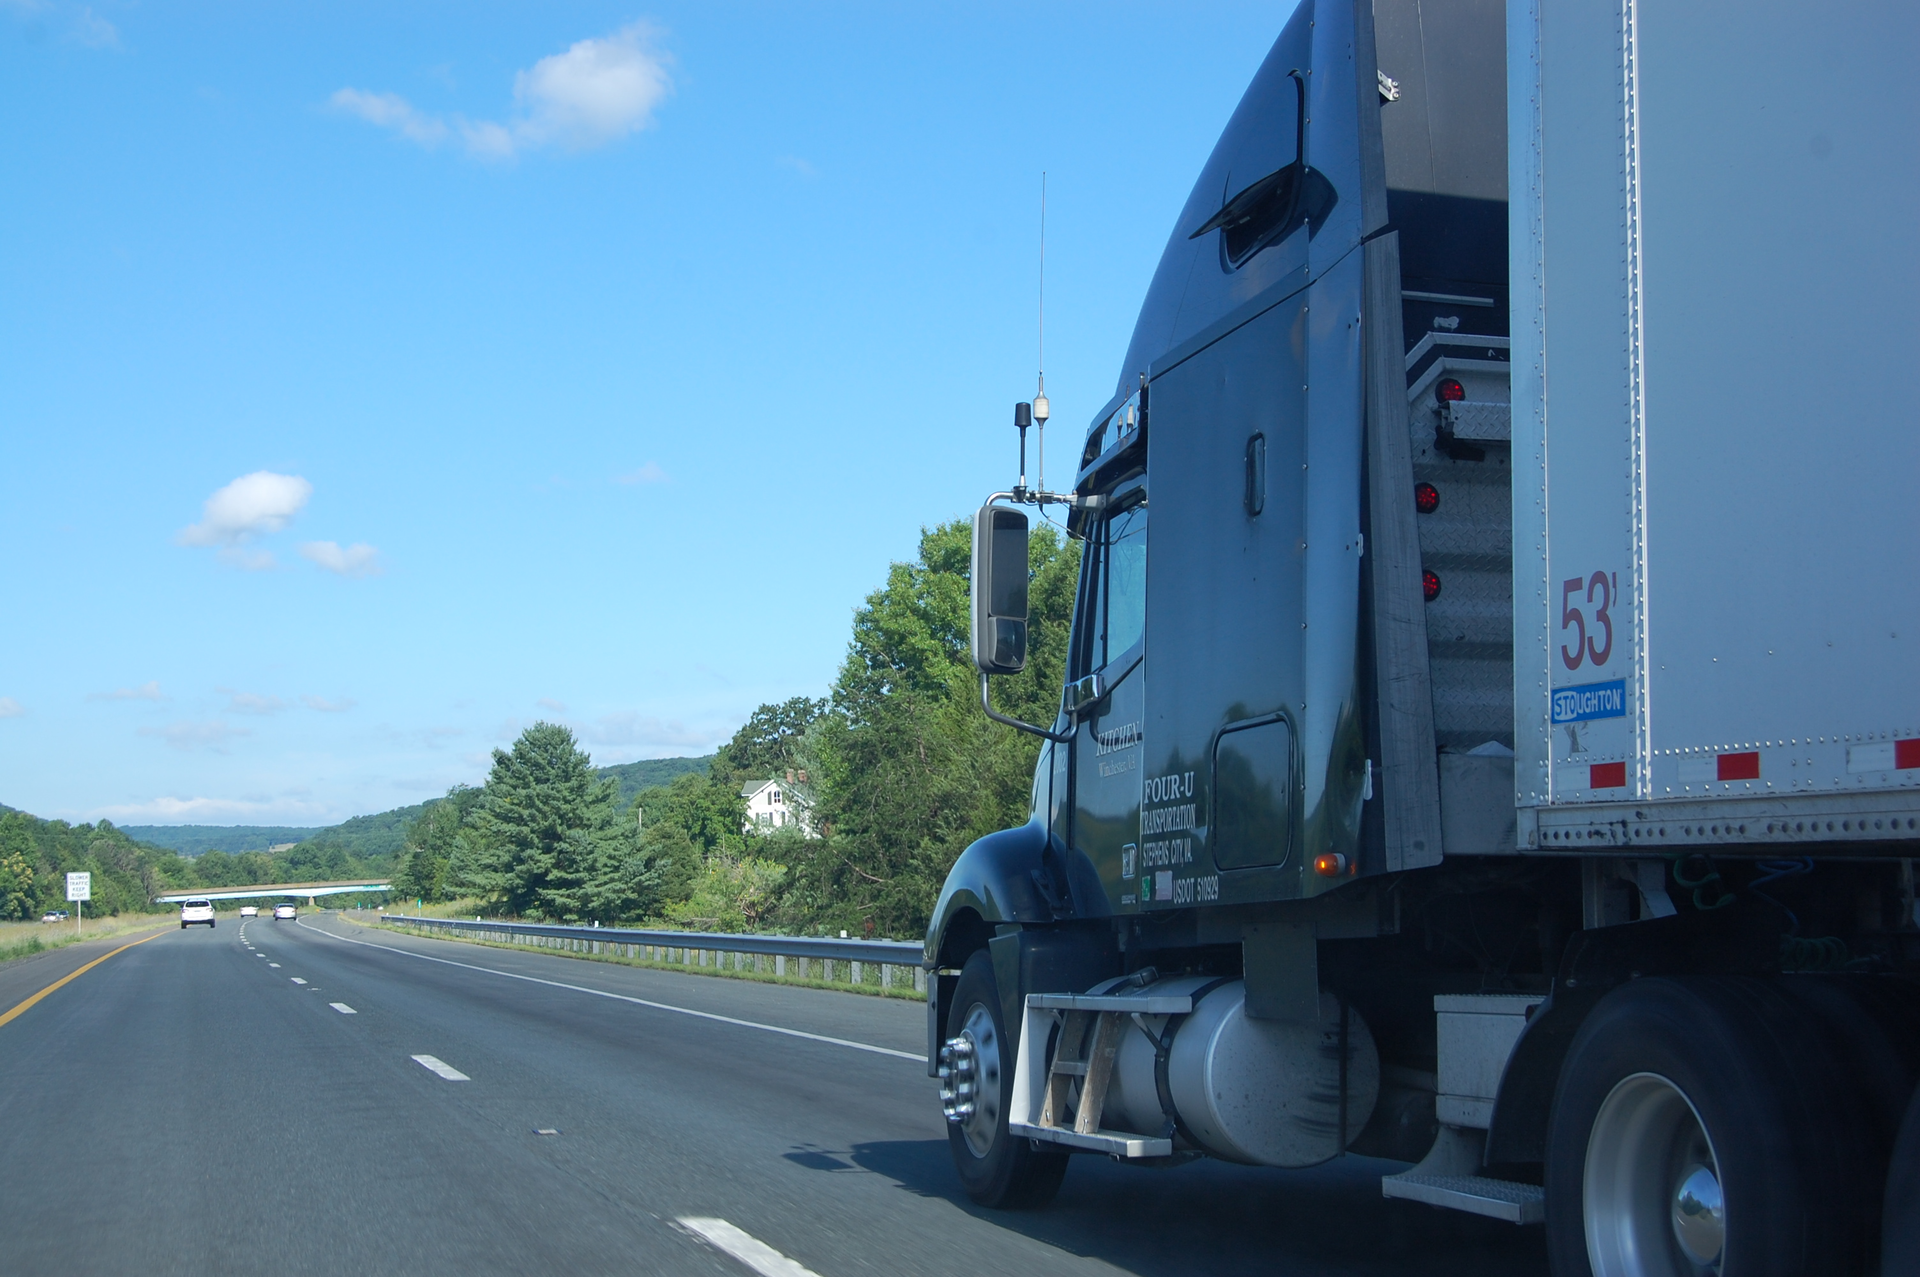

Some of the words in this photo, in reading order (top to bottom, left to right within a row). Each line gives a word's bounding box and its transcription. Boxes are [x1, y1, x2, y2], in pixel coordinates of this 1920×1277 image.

[1554, 688, 1621, 718] STOUGHTON
[1096, 721, 1139, 756] KITCHEN
[1144, 771, 1195, 804] FOUR-U
[1142, 804, 1196, 834] TRANSPORTATION
[1142, 840, 1169, 867] STEPHENS
[1174, 878, 1194, 904] USDOT
